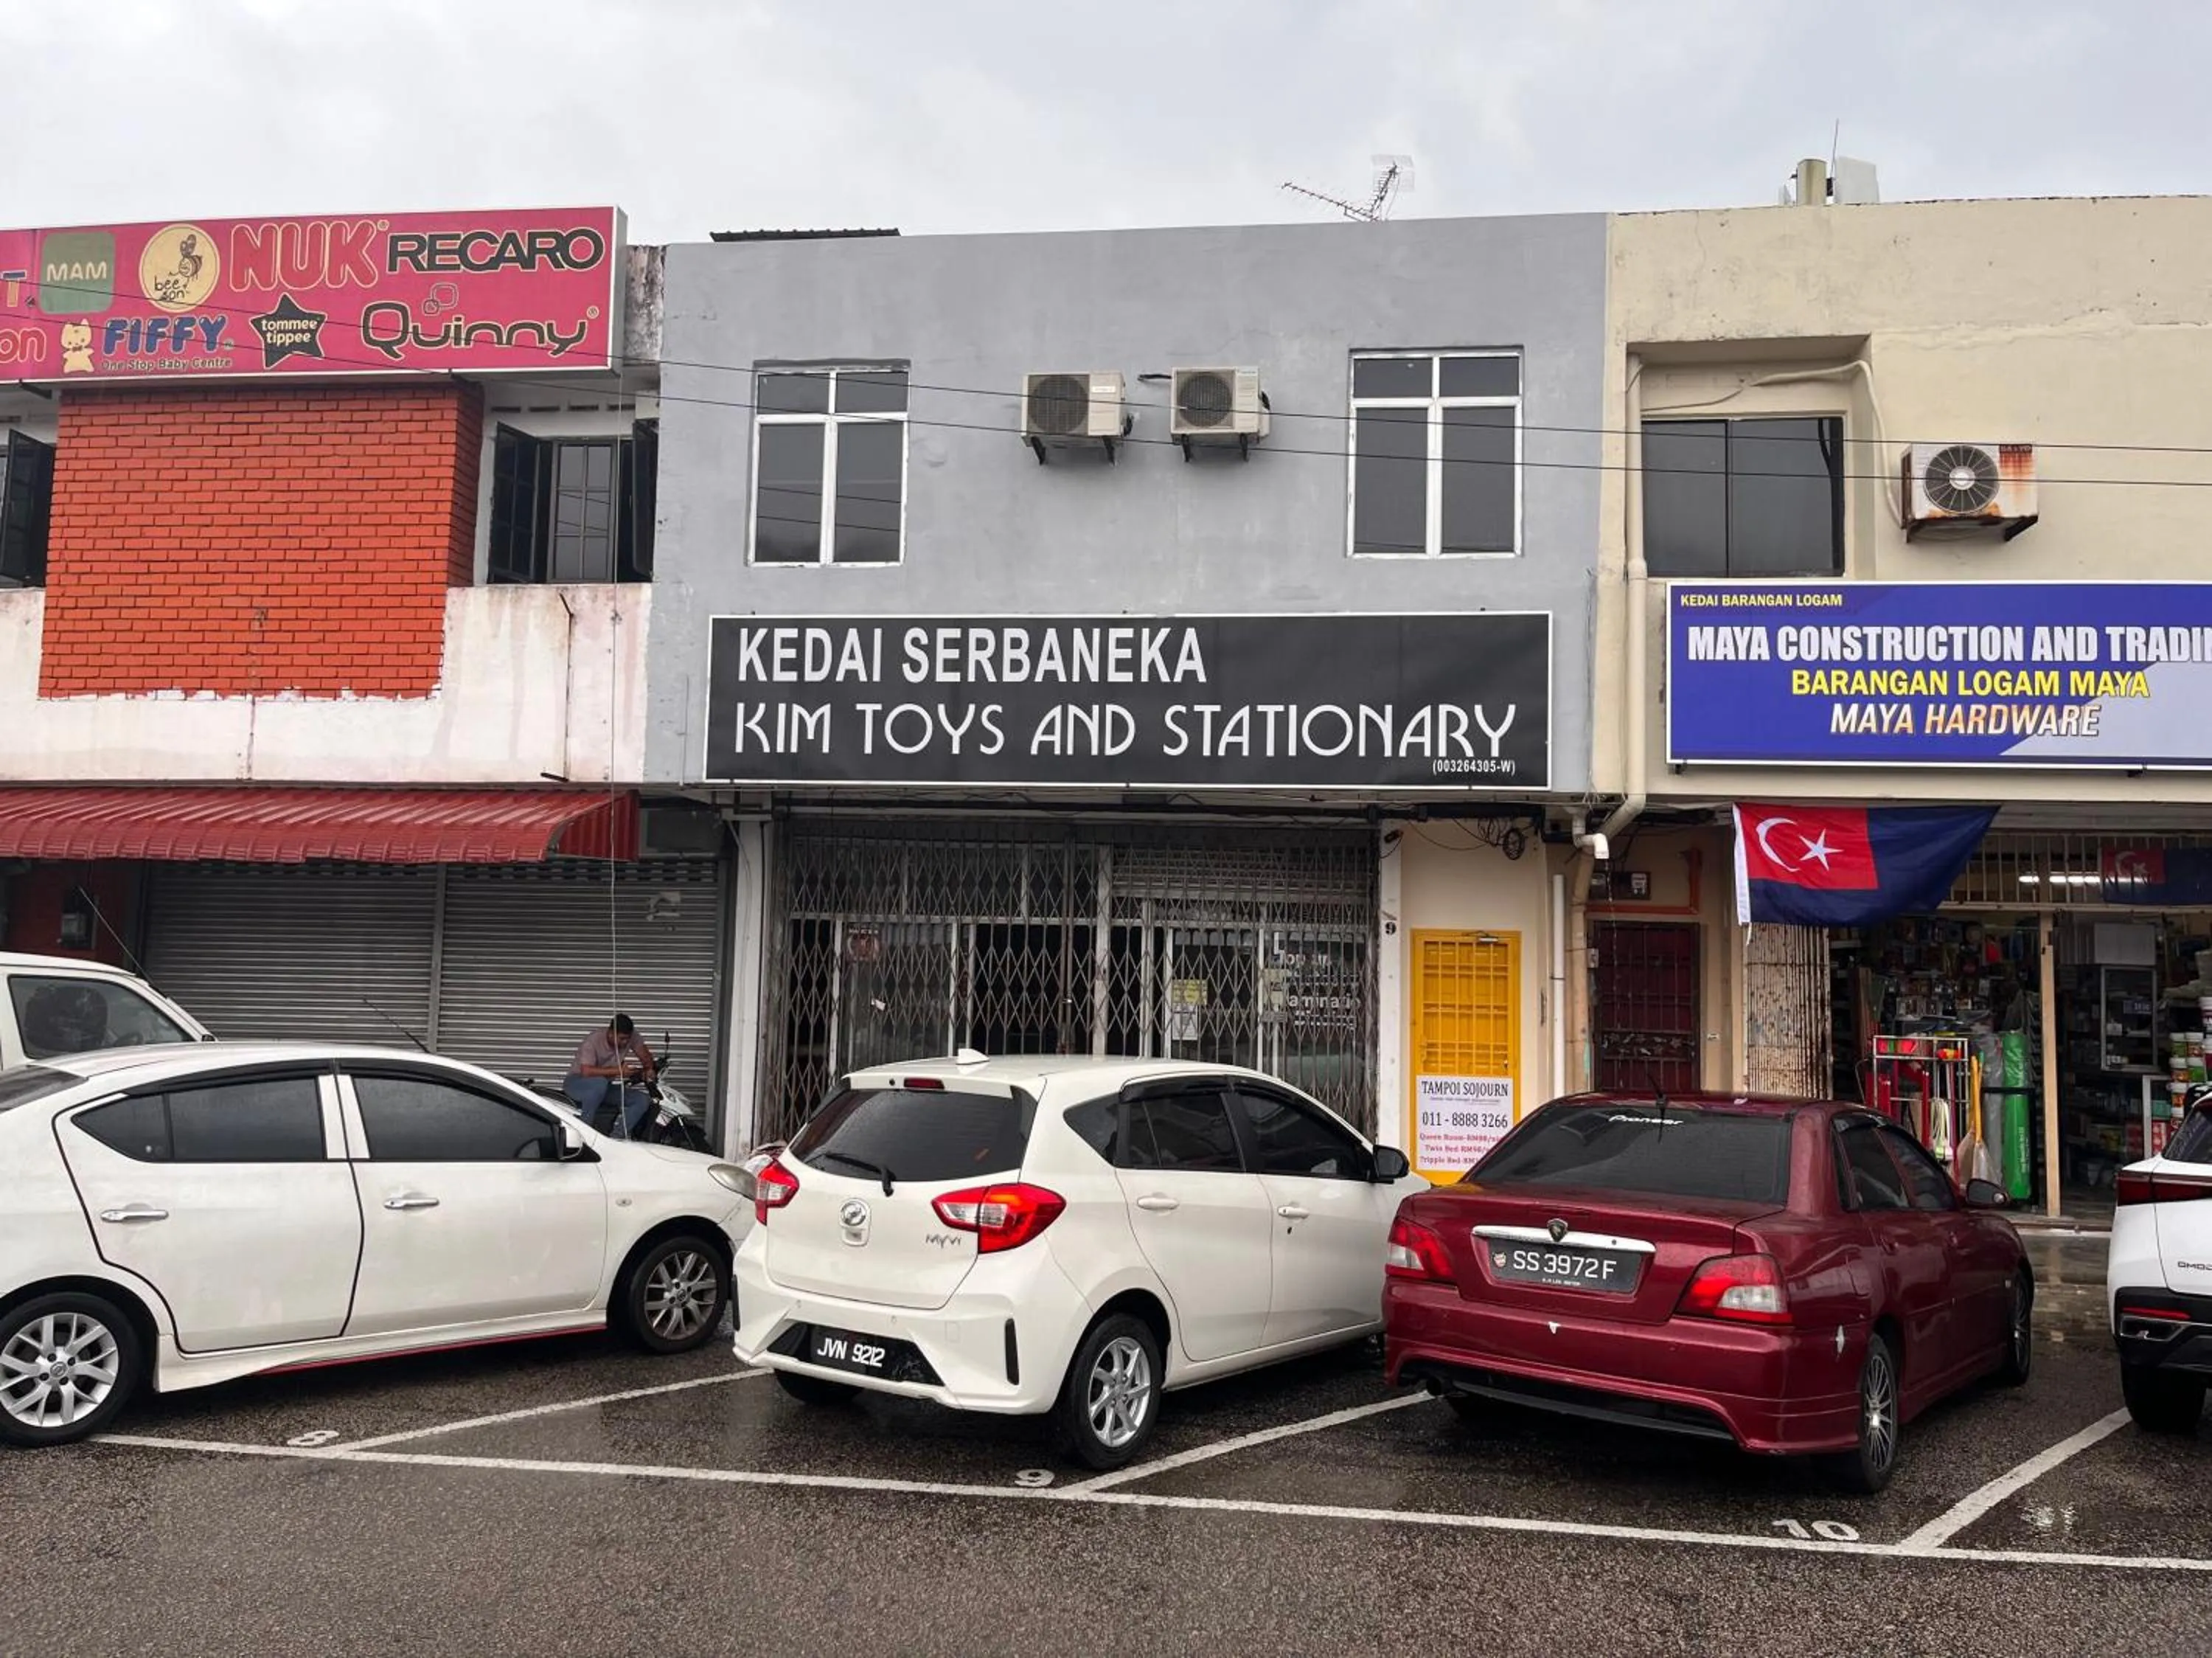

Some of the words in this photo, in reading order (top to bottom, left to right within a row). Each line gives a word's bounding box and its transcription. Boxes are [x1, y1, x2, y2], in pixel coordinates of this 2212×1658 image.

[229, 221, 378, 292] NUK
[387, 228, 605, 274] RECARO
[46, 261, 107, 282] MAM
[154, 274, 181, 291] bee
[102, 314, 228, 356] FIFFY
[261, 319, 318, 331] tommee
[361, 300, 588, 360] Quinny
[266, 330, 311, 347] tippee
[102, 359, 124, 370] One
[128, 358, 155, 371] Stop
[158, 358, 189, 371] Baby
[192, 356, 233, 370] Centre
[1681, 594, 1719, 607] KEDAI
[1722, 594, 1792, 607] BARANGAN
[1796, 594, 1843, 607] LOGAM
[1688, 625, 1771, 661] MAYA
[1777, 625, 2024, 662] CONSTRUCTION
[2031, 625, 2098, 662] AND
[738, 628, 883, 683] KEDAI
[902, 627, 1207, 684] SERBANEKA
[1792, 669, 1947, 696] BARANGAN
[1958, 670, 2059, 697] LOGAM
[2069, 670, 2150, 698] MAYA
[735, 702, 832, 753] KIM
[855, 703, 1006, 755] TOYS
[1030, 704, 1136, 756] AND
[1163, 704, 1517, 757] STATIONARY
[1830, 703, 1915, 735] MAYA
[1924, 704, 2102, 736] HARDWARE
[1433, 759, 1515, 777] (003264305-W)
[1385, 921, 1397, 935] 9
[1422, 1081, 1461, 1095] TAMPOI
[1463, 1082, 1508, 1097] SOJOURN
[1422, 1111, 1442, 1126] 011
[1452, 1112, 1478, 1127] 8888
[1481, 1113, 1508, 1128] 3266
[1514, 1250, 1540, 1271] SS
[1543, 1252, 1599, 1279] 3972
[1602, 1259, 1617, 1280] F
[817, 1337, 848, 1360] JVN
[852, 1343, 886, 1368] 9212
[287, 1430, 340, 1446] 8
[1014, 1468, 1055, 1488] 9
[1772, 1519, 1860, 1541] 10
